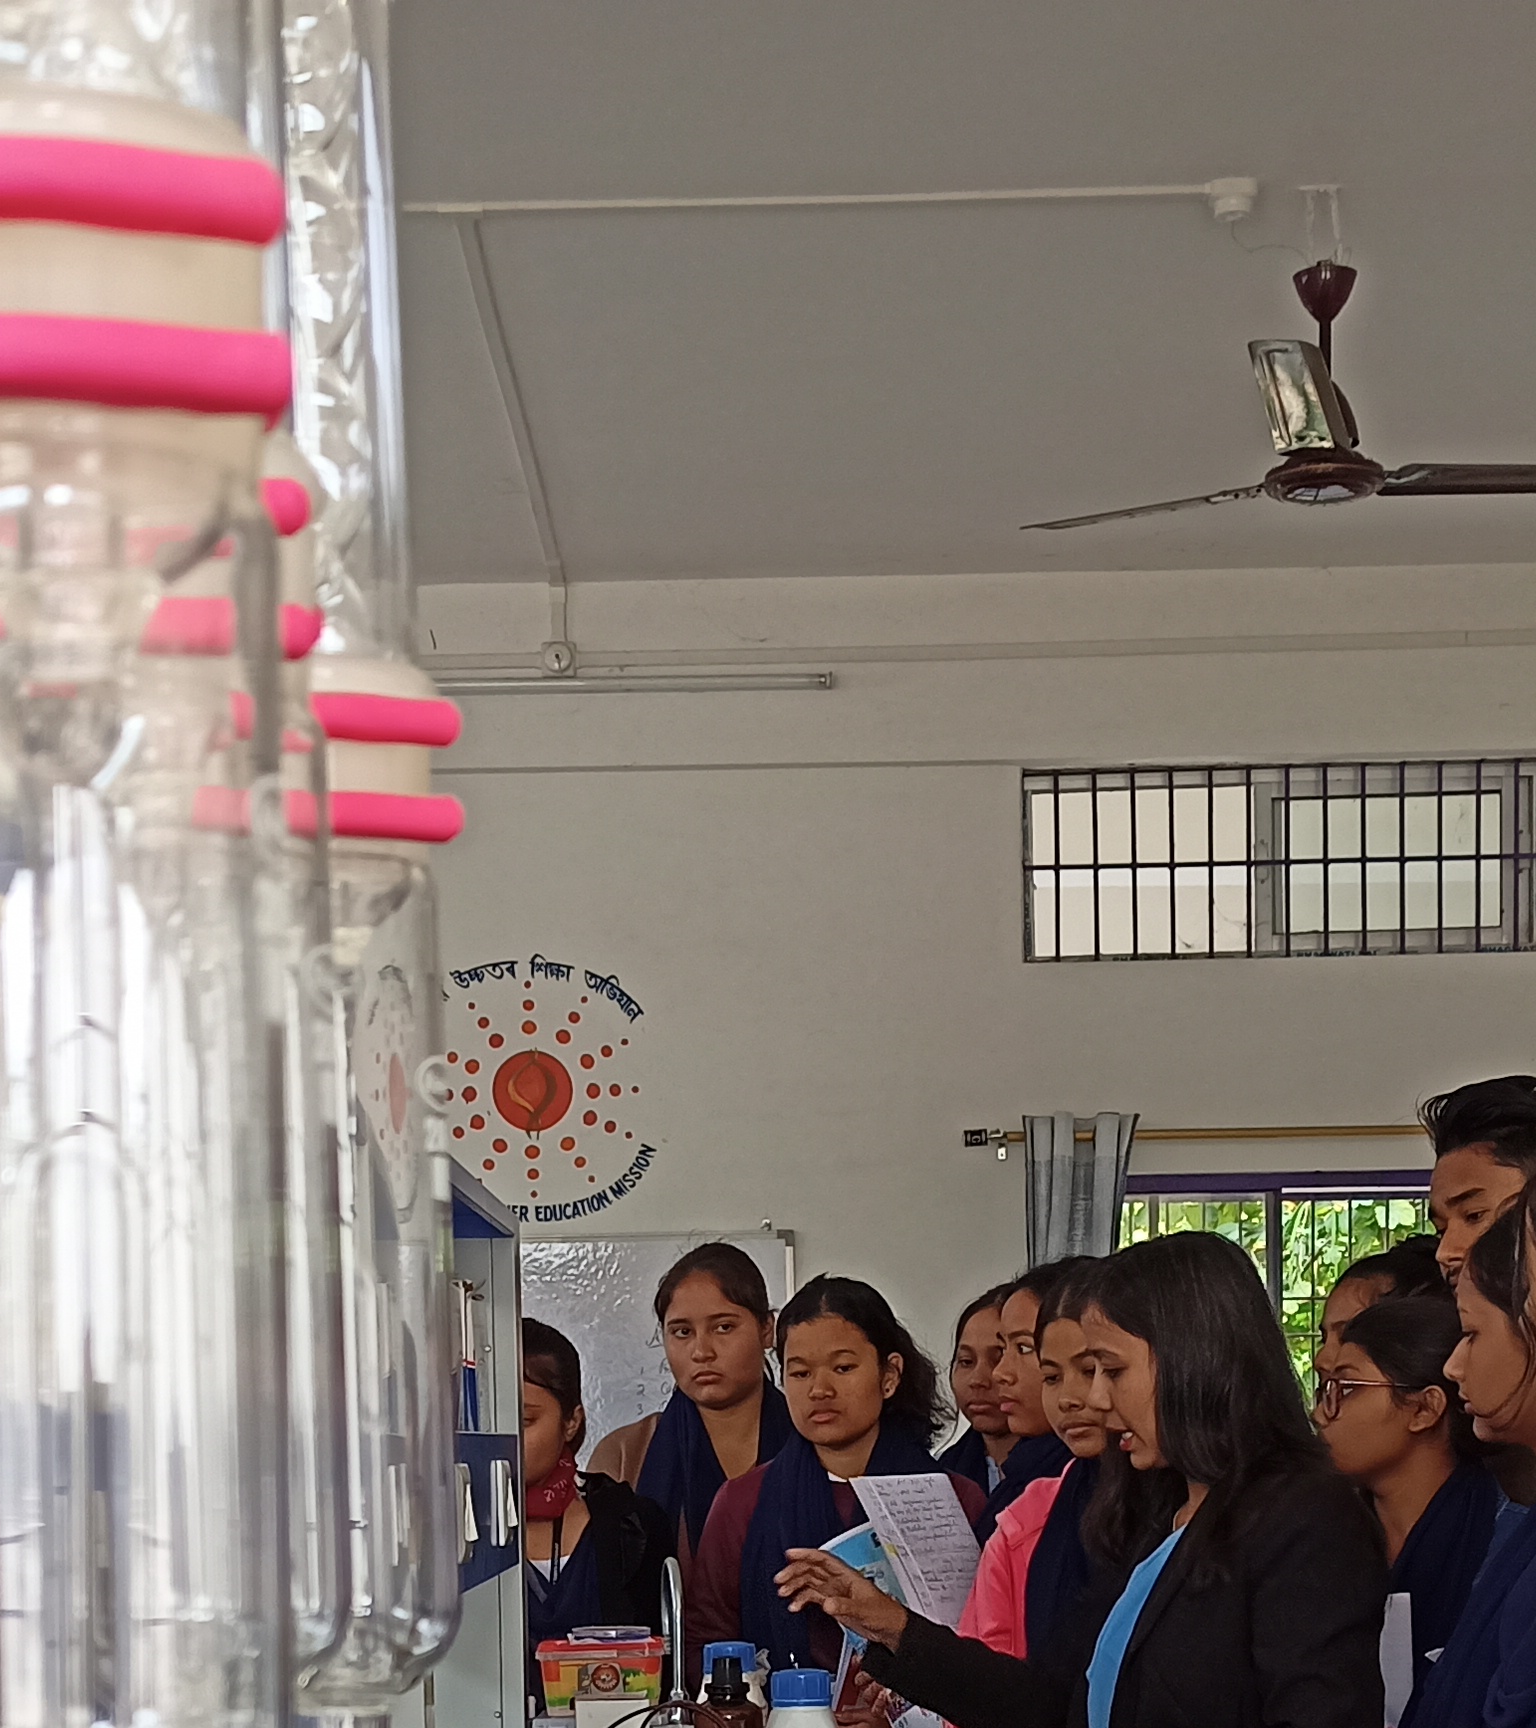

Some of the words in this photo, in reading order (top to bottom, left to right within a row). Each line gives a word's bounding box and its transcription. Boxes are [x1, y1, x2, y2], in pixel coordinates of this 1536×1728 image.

[529, 953, 575, 983] শিক্ষা
[534, 1189, 613, 1223] EDUCATION
[608, 1143, 658, 1201] MISSION
